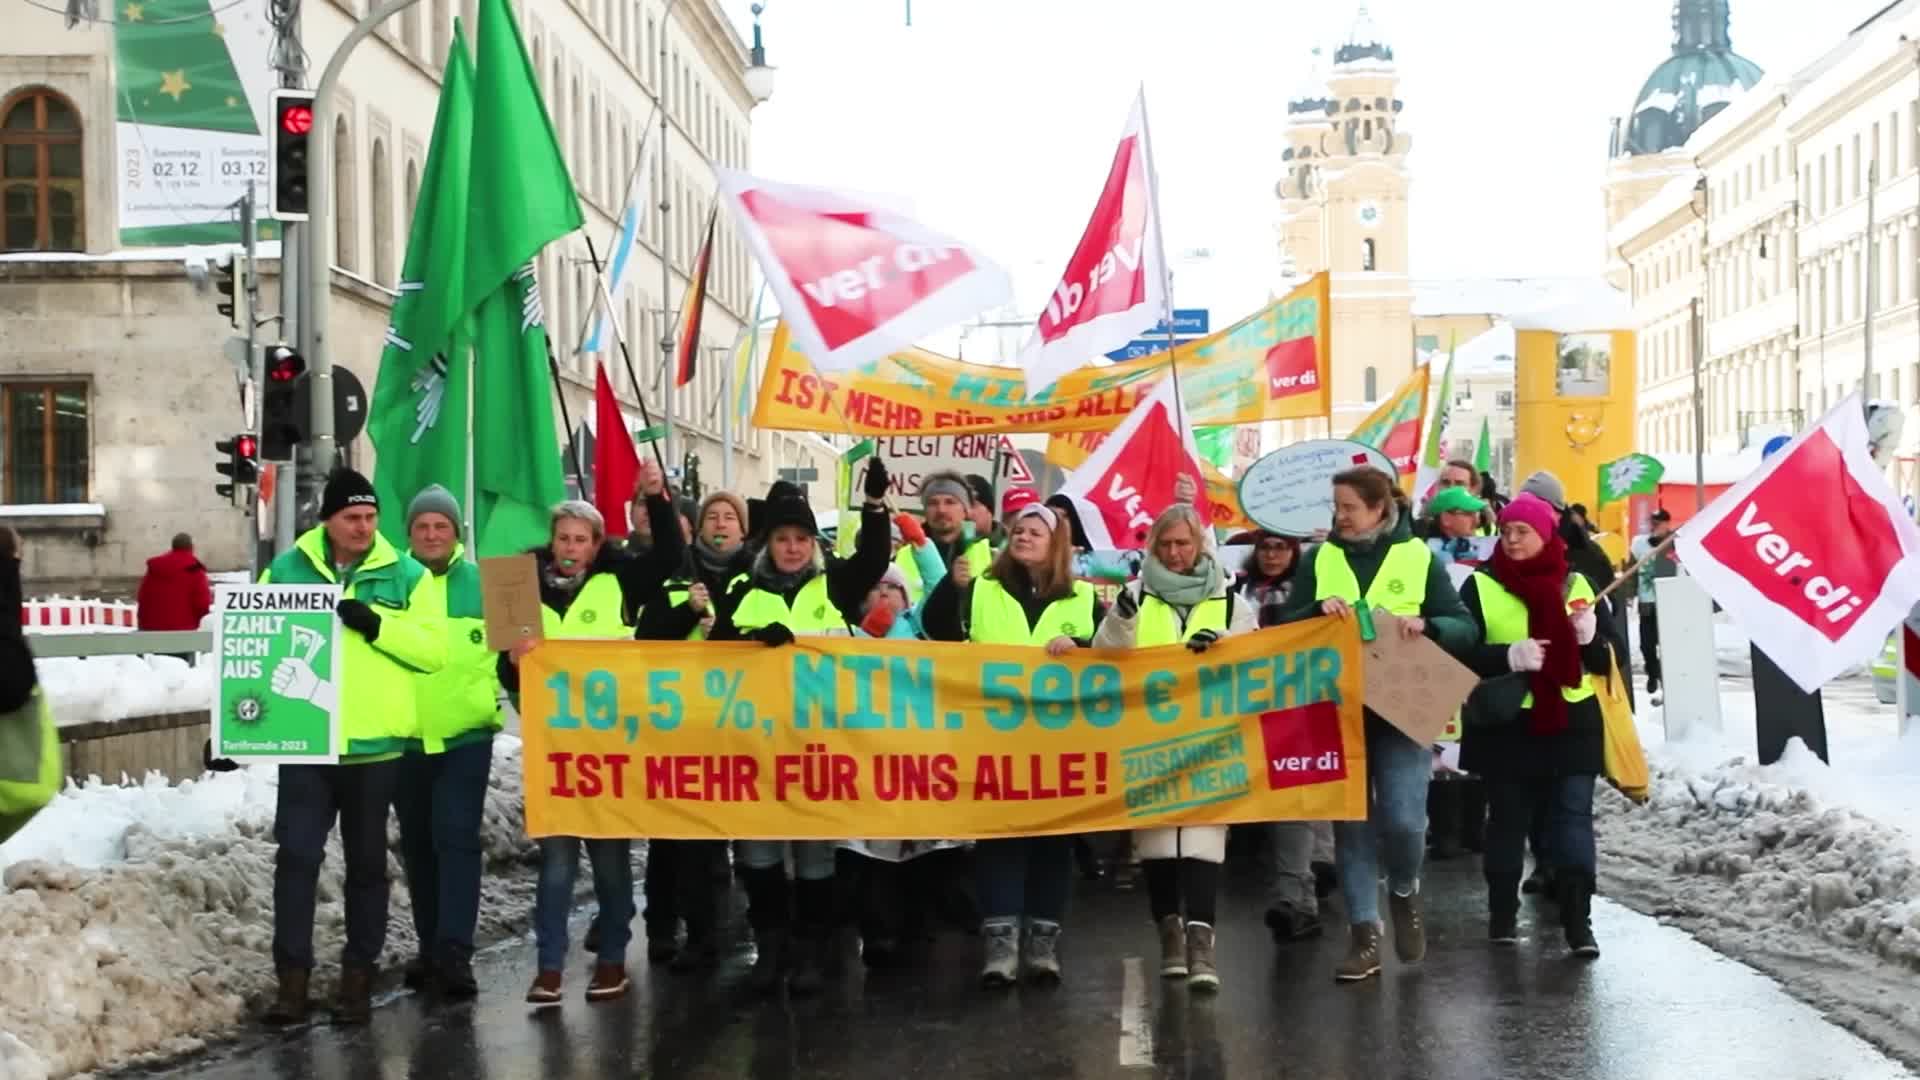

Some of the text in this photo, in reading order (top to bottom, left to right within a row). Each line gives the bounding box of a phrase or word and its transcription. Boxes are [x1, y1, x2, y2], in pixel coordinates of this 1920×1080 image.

[775, 367, 839, 414] IST
[844, 389, 922, 431] MEHR
[224, 615, 286, 634] ZAHLT
[226, 592, 335, 610] ZUSAMMEN
[223, 660, 262, 678] AUS
[224, 637, 270, 656] SICH
[545, 669, 684, 743] 10,5
[794, 653, 964, 729] MIN.
[980, 661, 1125, 731] 500
[1143, 670, 1182, 724] €
[1196, 646, 1342, 718] MEHR
[547, 743, 1107, 801] IST MEHR FÜR UNS ALLE!
[1123, 732, 1245, 784] ZUSAMMEN
[1124, 761, 1249, 809] GEHT MEHR
